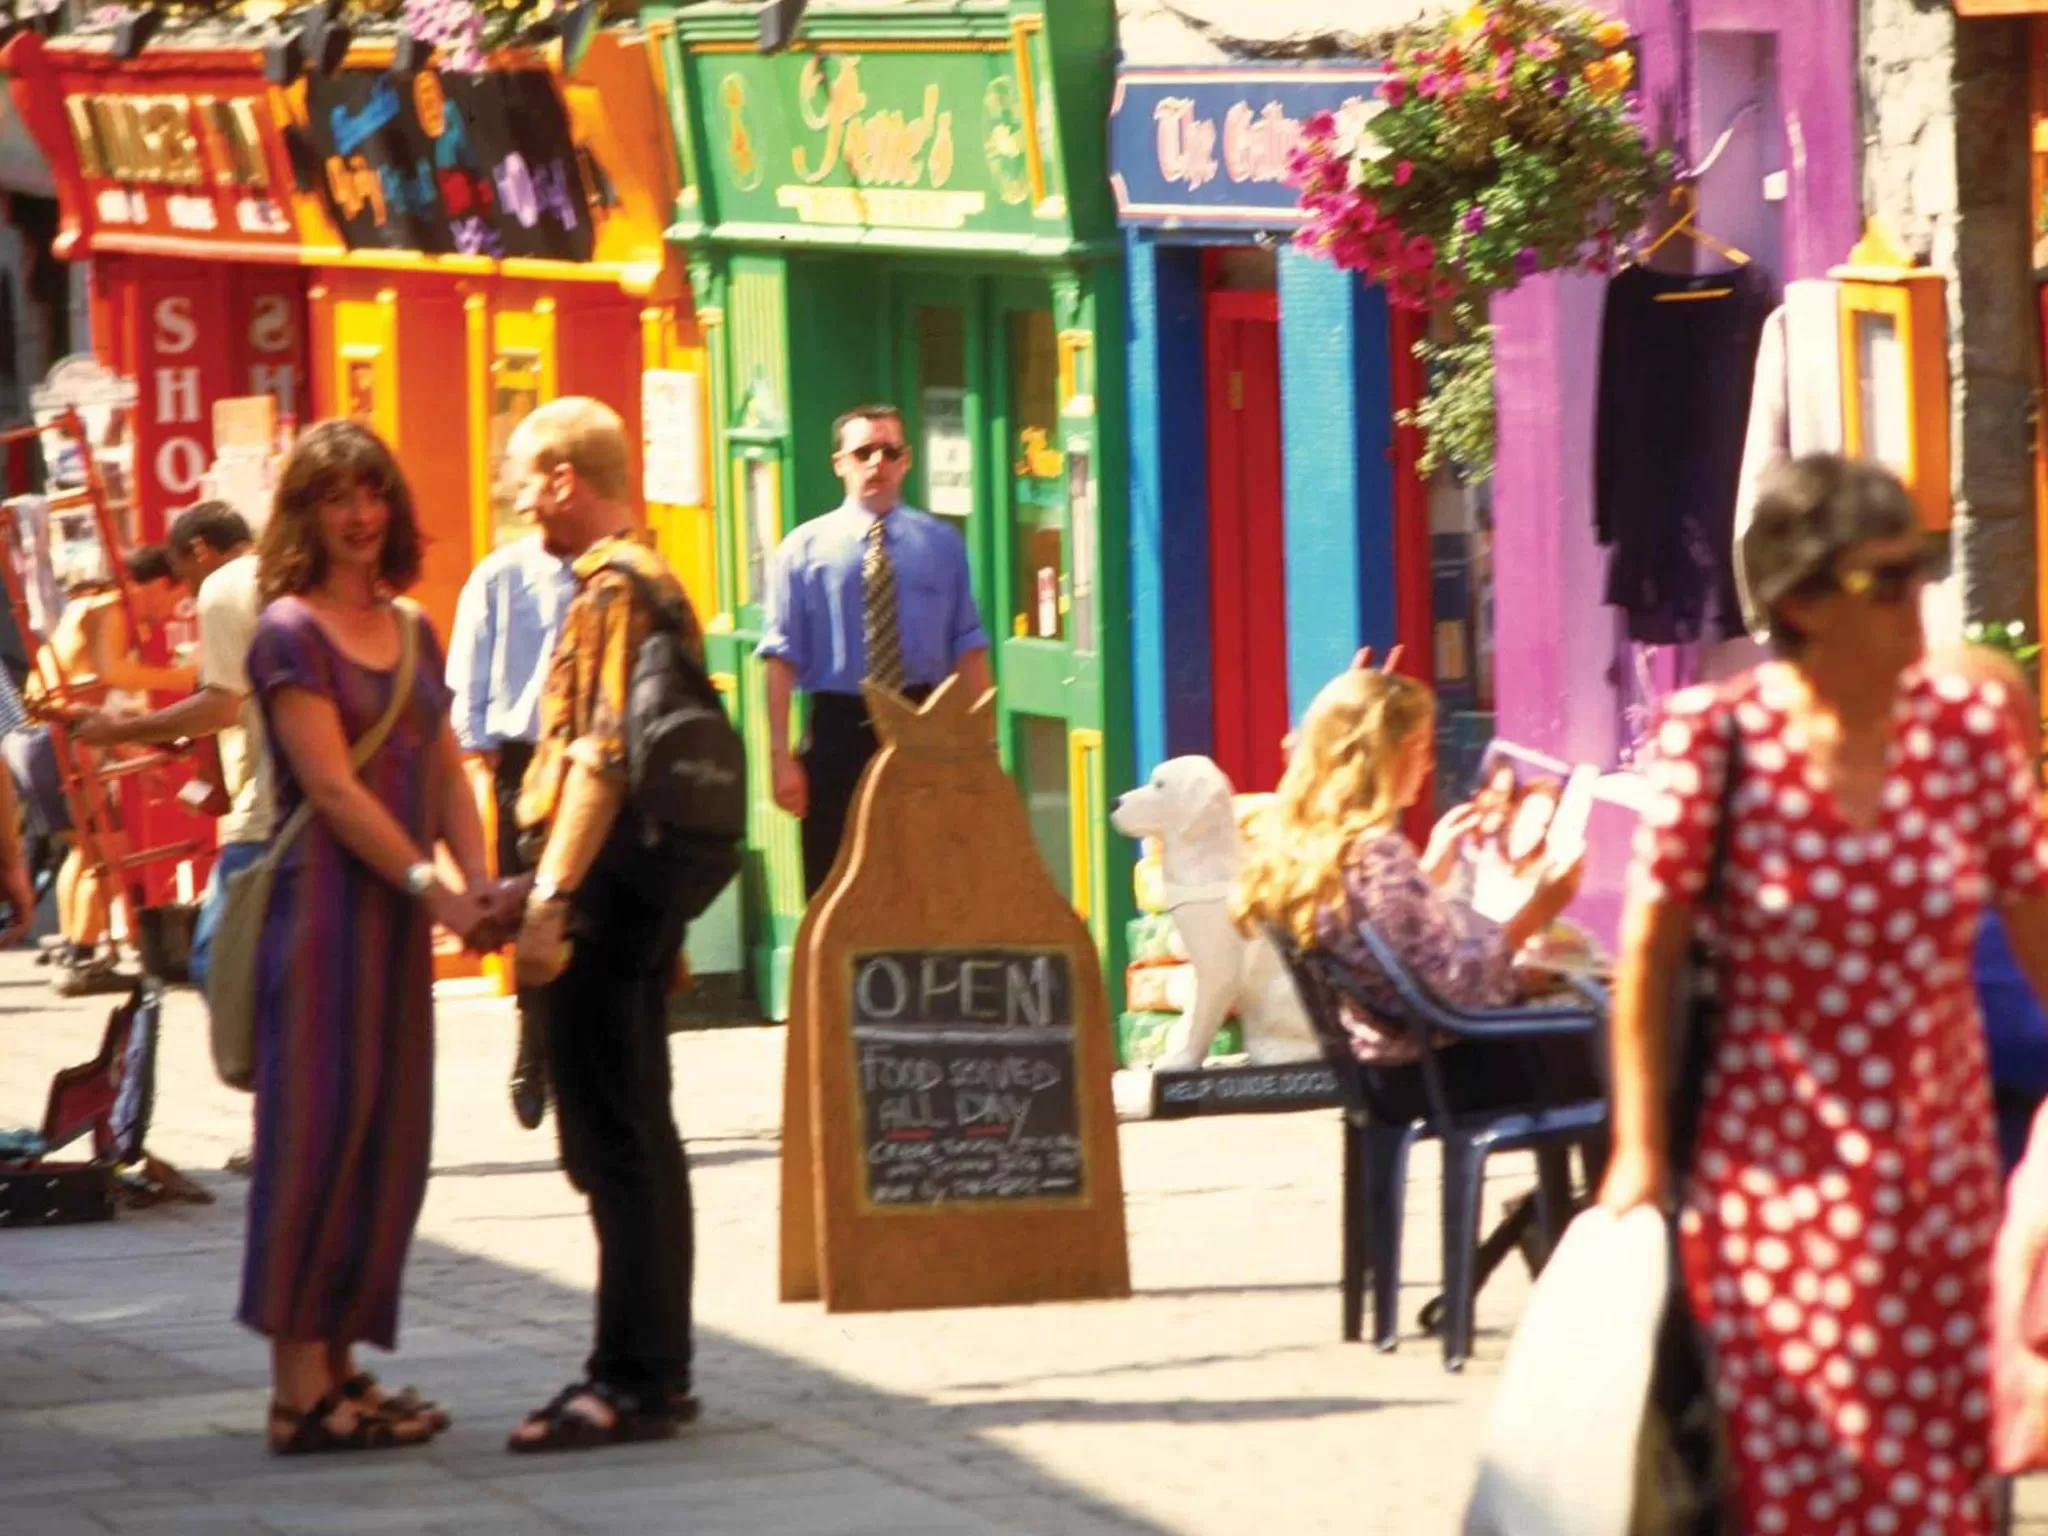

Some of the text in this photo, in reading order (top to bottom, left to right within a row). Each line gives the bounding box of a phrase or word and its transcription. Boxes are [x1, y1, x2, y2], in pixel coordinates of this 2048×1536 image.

[155, 296, 207, 530] SHO
[857, 956, 1055, 1027] OPEN
[860, 1045, 944, 1092] FOOD
[1163, 1077, 1215, 1102] HELP
[1216, 1073, 1279, 1098] GUIDE
[956, 1090, 1035, 1147] DAY
